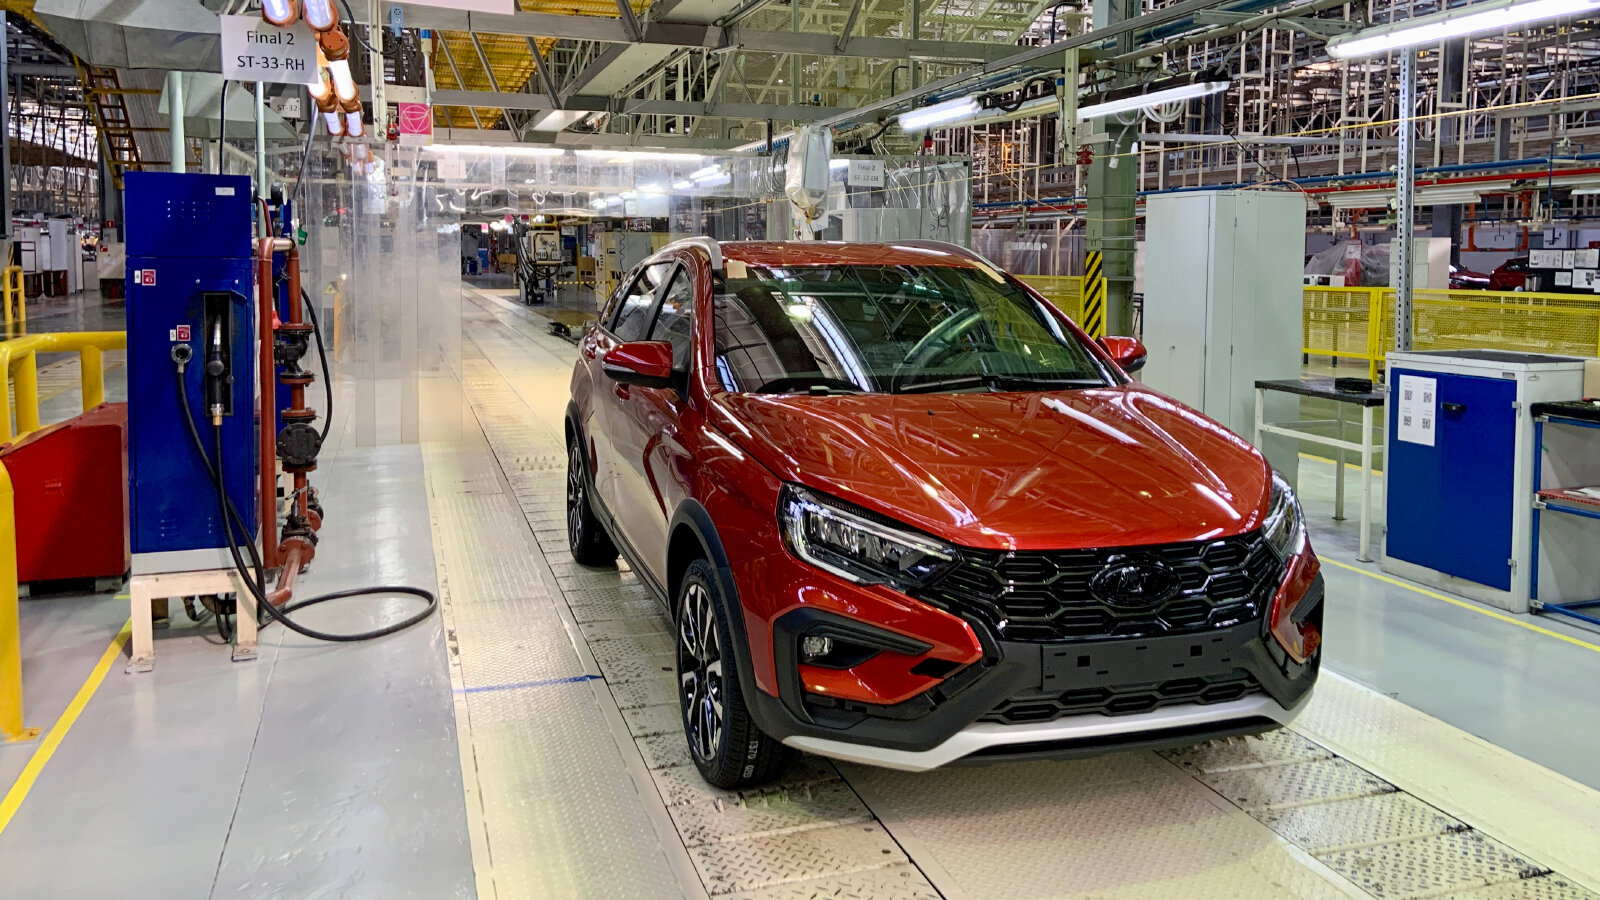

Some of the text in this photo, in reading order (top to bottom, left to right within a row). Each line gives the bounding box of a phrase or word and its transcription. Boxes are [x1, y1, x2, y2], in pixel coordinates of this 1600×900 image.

[247, 30, 295, 46] Final 2
[237, 55, 305, 71] ST-33-RH
